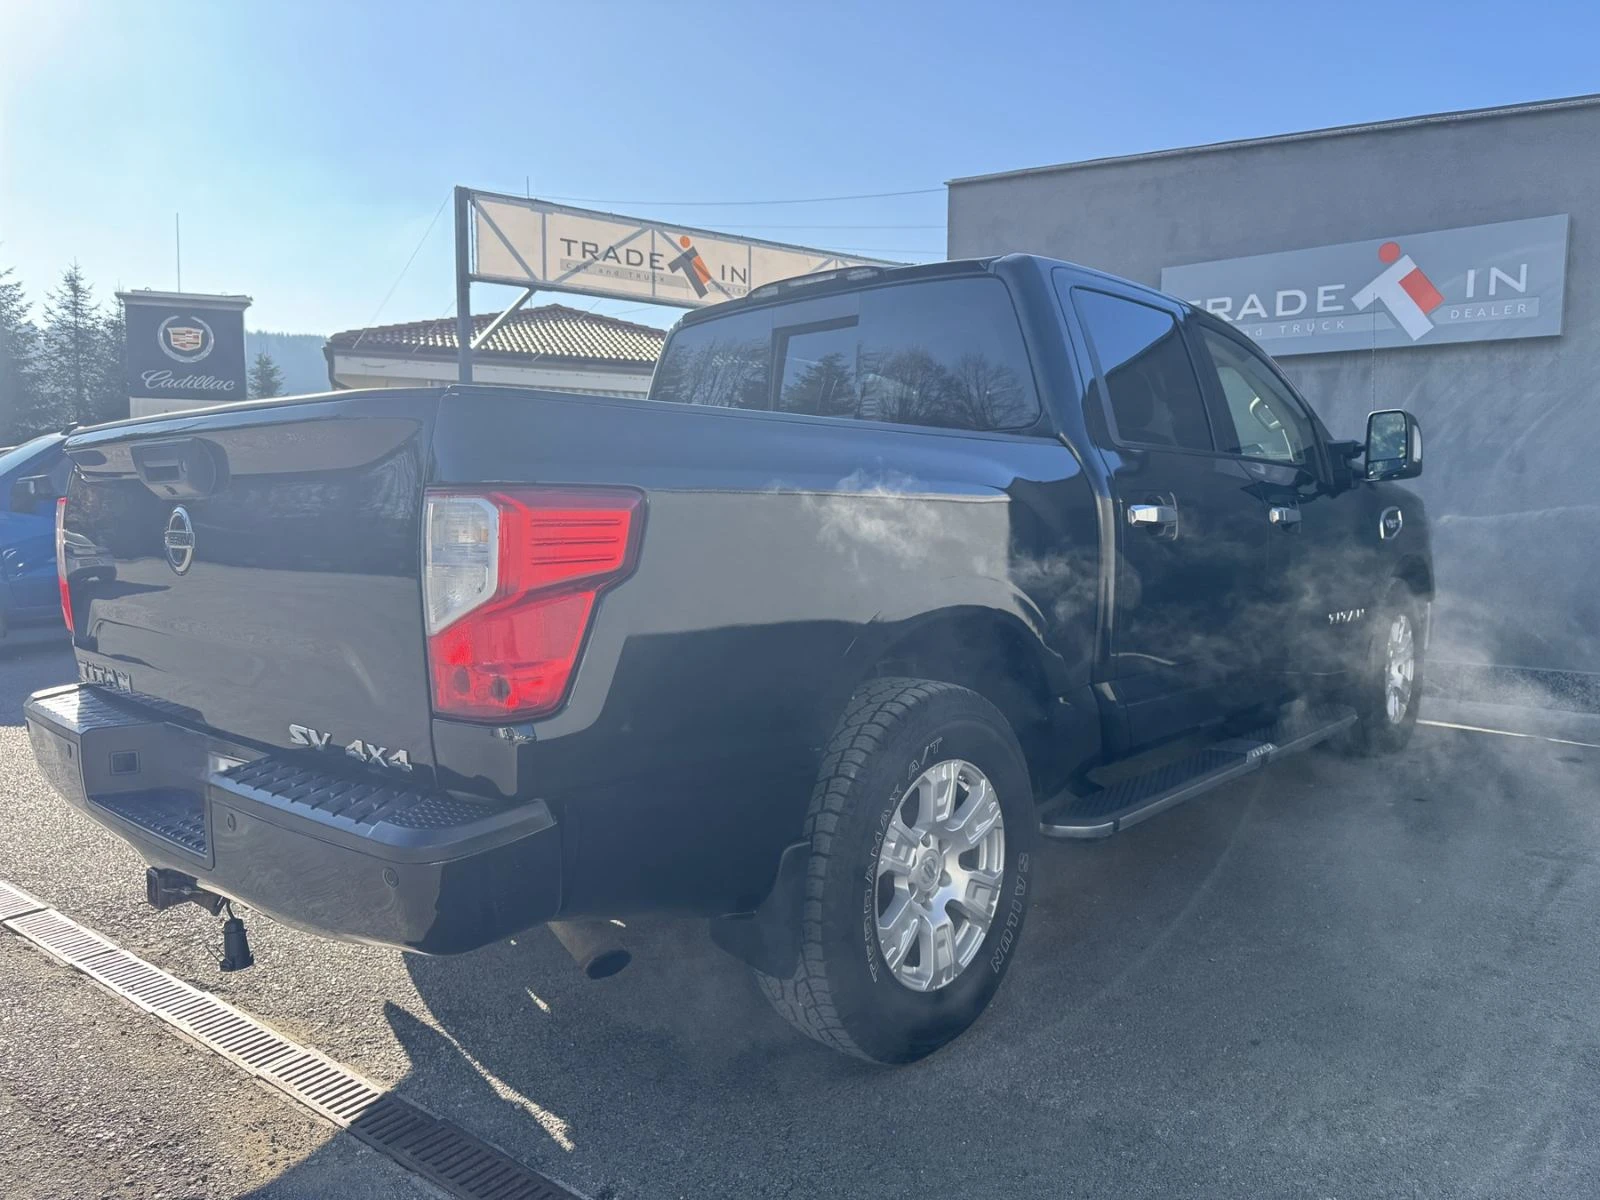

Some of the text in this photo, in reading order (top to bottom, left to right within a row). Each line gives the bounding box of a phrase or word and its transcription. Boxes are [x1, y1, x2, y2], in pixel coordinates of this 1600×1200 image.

[560, 237, 747, 284] TRADE IN
[1466, 264, 1528, 298] IN
[1280, 320, 1344, 336] TRUCK
[1451, 304, 1527, 319] DEALER
[141, 369, 235, 391] Cadillac
[289, 724, 413, 772] SV 4X4
